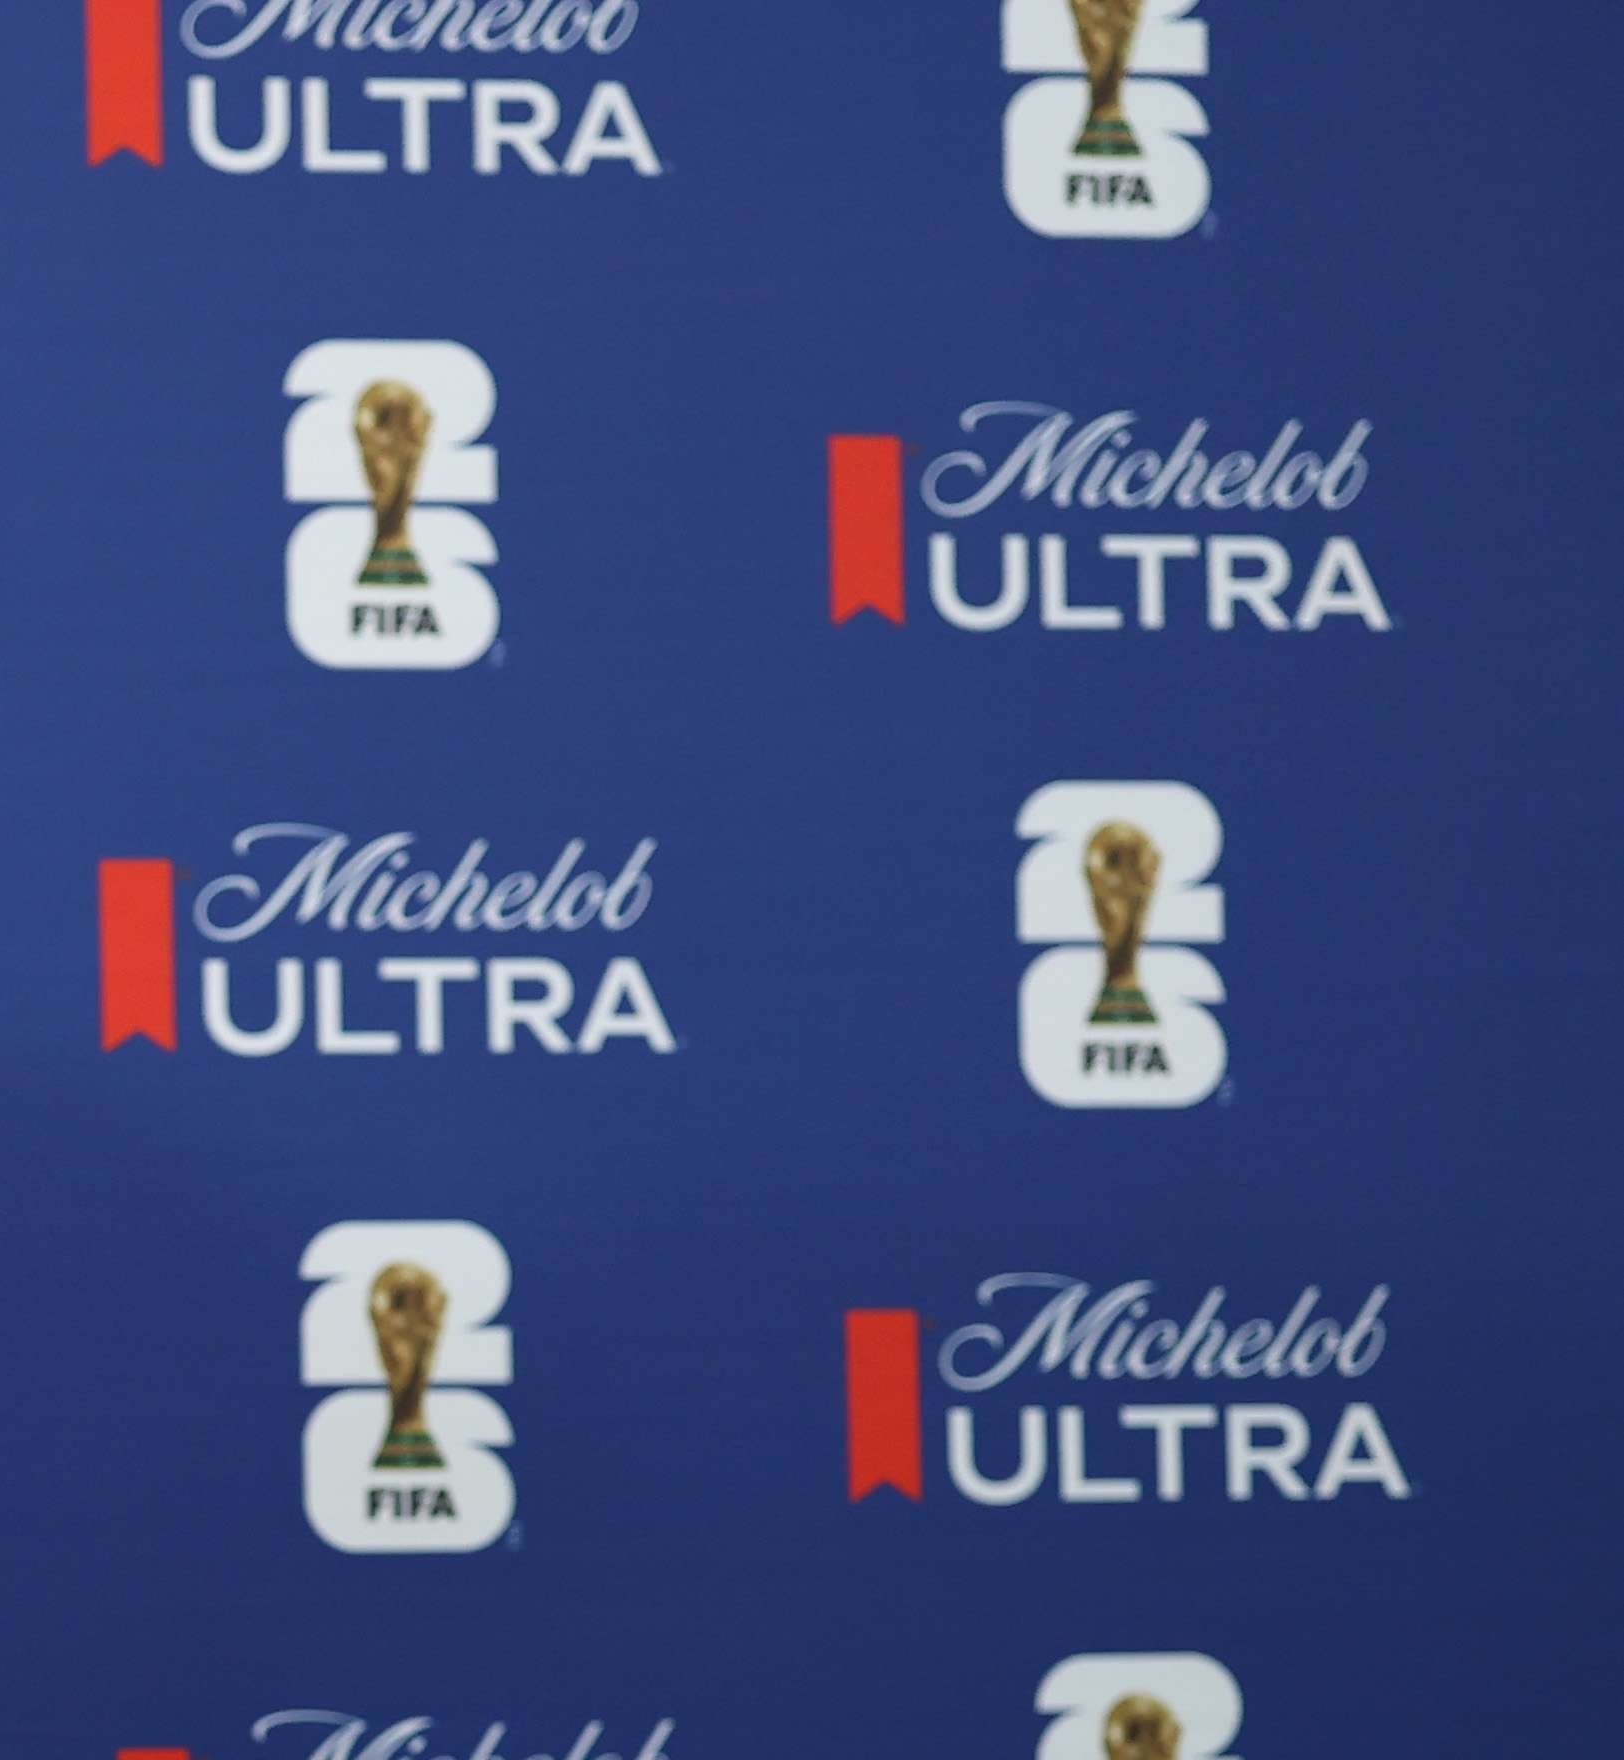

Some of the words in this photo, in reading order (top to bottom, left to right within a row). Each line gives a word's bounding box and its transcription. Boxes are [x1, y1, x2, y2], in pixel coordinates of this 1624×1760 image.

[188, 75, 661, 176] ULTRA
[1066, 173, 1153, 205] FIFA
[922, 401, 1371, 518] Michelob
[351, 604, 440, 635] FIFA
[929, 533, 1390, 631] ULTRA
[194, 823, 656, 942] Michelob
[202, 957, 675, 1057] ULTRA
[1082, 1042, 1170, 1074] FIFA
[939, 1273, 1389, 1391] Michelob
[367, 1487, 456, 1519] FIFA
[947, 1403, 1409, 1506] ULTRA
